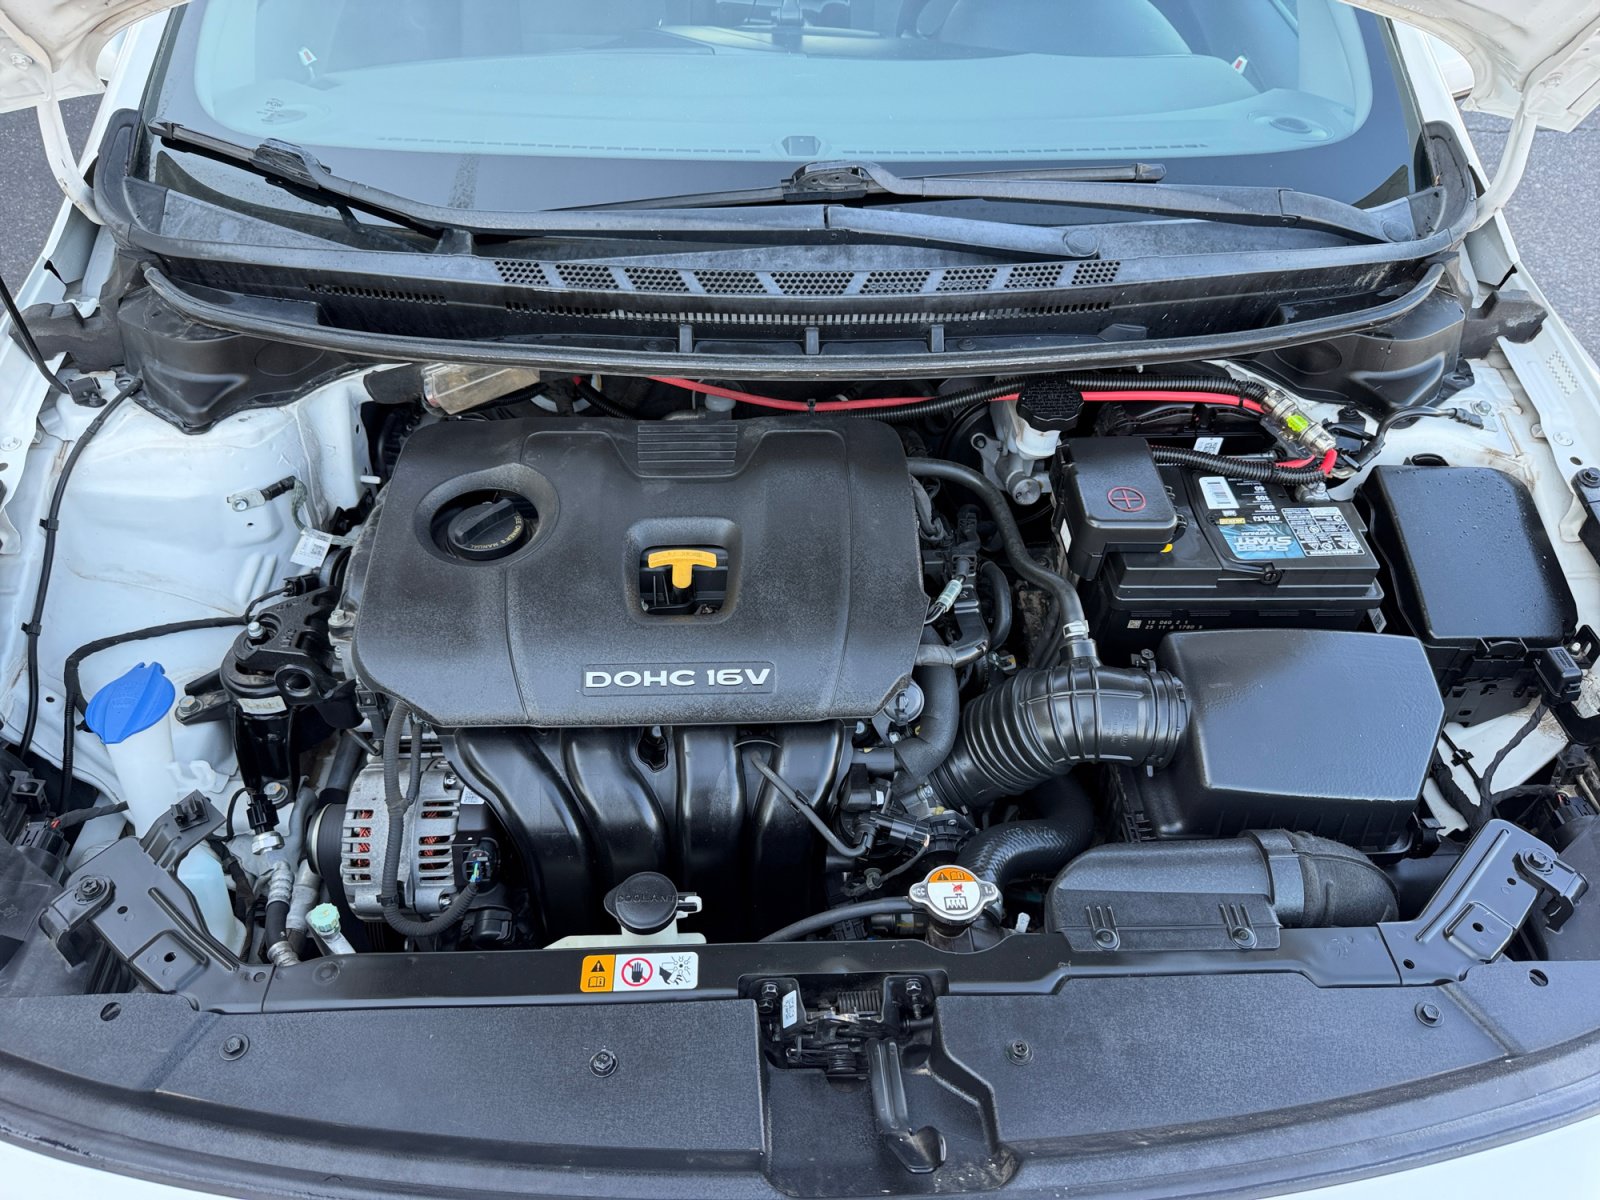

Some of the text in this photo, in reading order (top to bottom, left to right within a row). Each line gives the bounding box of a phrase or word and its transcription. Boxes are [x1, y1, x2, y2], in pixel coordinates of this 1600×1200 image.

[1234, 536, 1292, 545] START
[1236, 544, 1289, 552] SUPER
[585, 668, 771, 688] DOHC 16V
[617, 893, 677, 903] COOLANT
